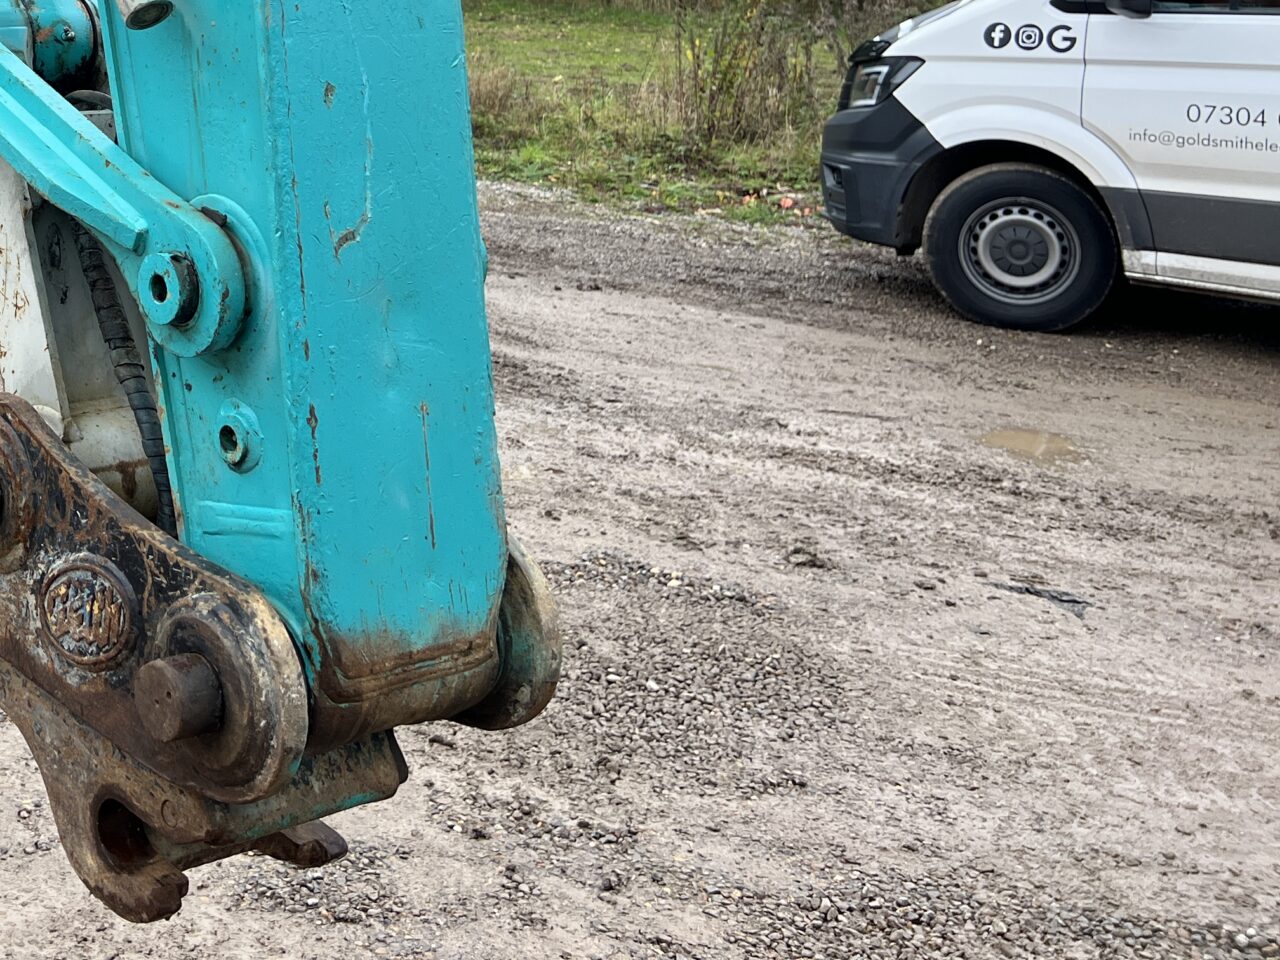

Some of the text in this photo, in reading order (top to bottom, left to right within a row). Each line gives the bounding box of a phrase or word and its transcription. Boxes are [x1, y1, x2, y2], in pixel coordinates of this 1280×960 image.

[1047, 24, 1077, 53] G
[1186, 103, 1267, 127] 07304
[1129, 128, 1280, 152] info@goldsmithele
